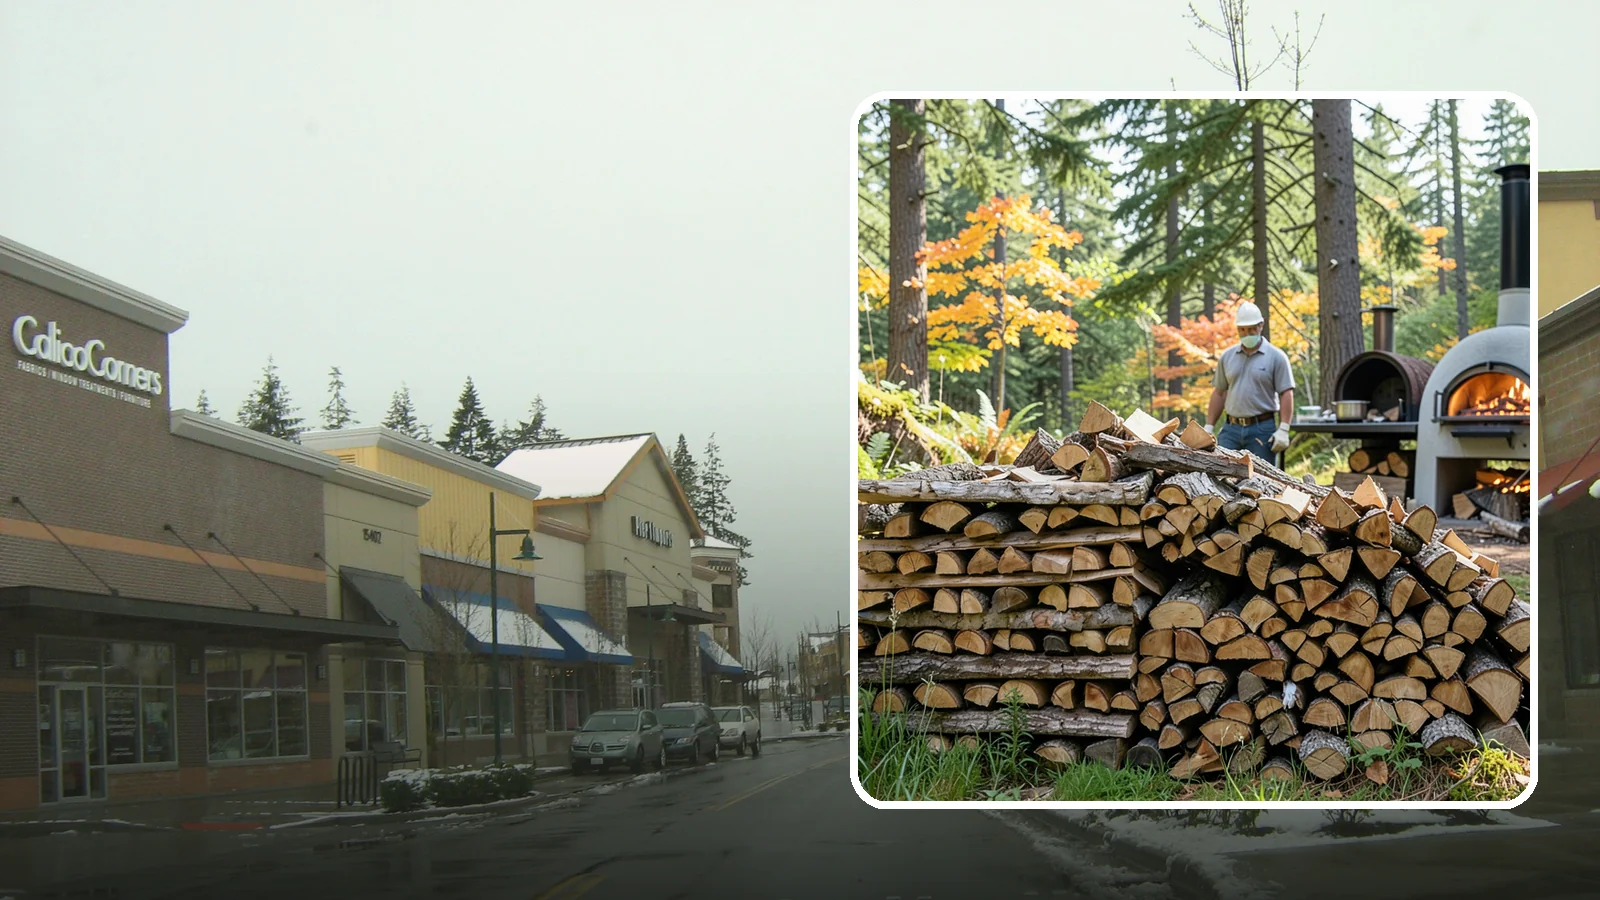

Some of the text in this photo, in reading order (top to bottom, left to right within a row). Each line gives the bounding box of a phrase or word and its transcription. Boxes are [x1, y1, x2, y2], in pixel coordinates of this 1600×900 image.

[17, 360, 151, 408] FABRICS WINDOW TREATMENTS FURNITURE
